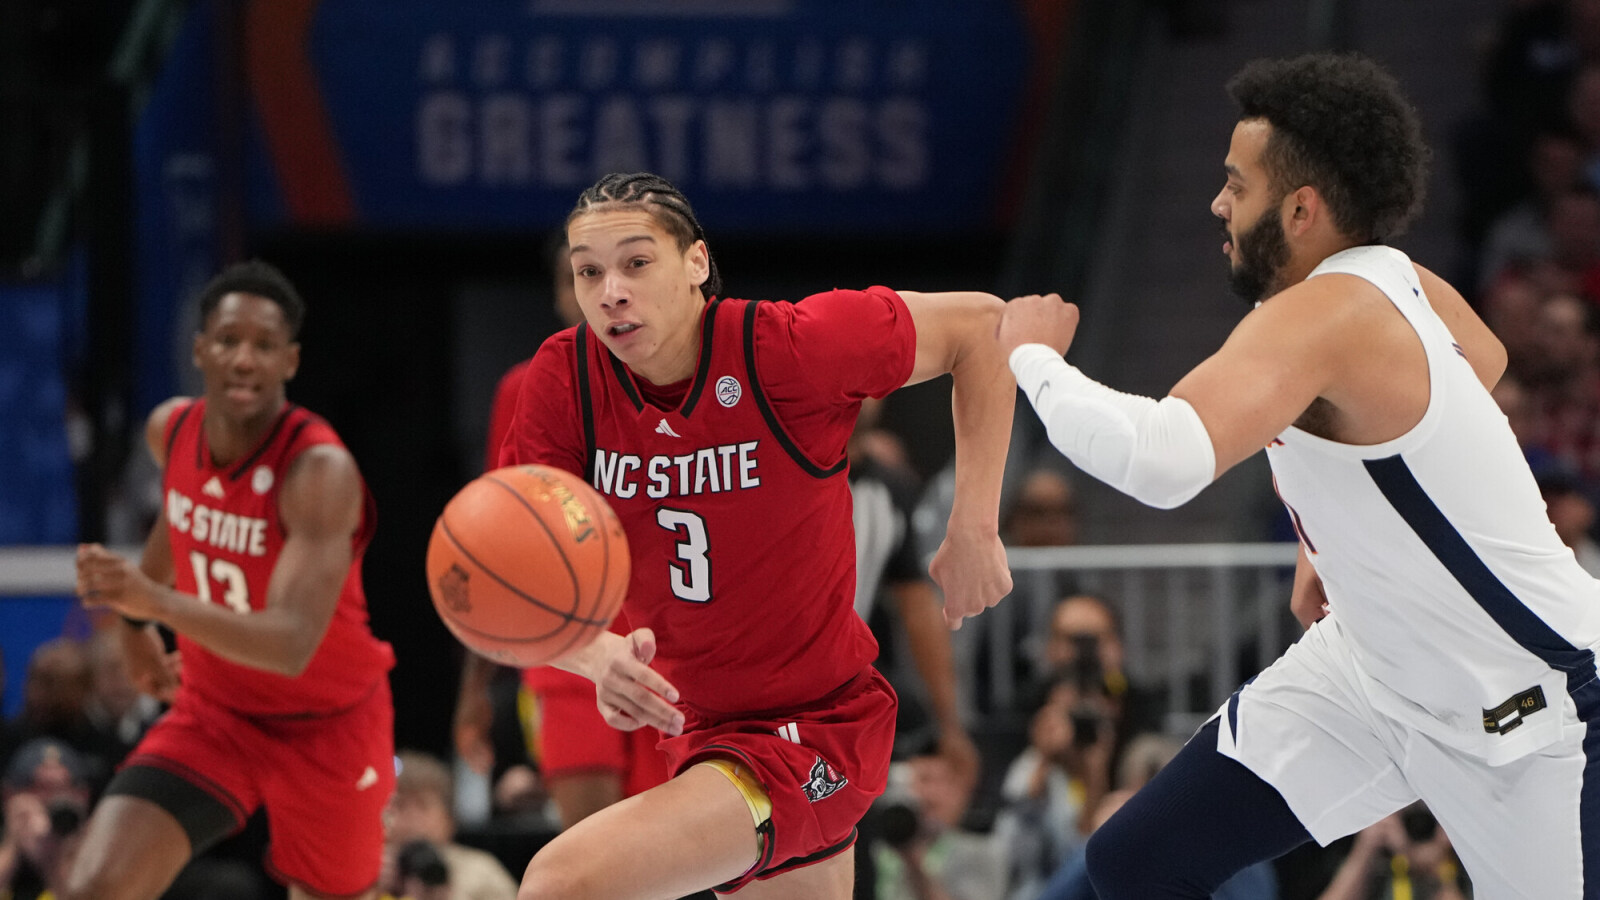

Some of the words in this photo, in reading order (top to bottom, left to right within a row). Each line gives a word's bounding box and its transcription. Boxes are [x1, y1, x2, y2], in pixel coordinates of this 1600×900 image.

[417, 95, 931, 187] GREATNESS
[720, 384, 738, 394] ACC
[593, 447, 642, 500] NC
[646, 440, 760, 499] STATE
[167, 488, 193, 534] NC
[191, 504, 268, 557] STATE
[655, 505, 714, 603] 3
[189, 549, 251, 616] 13
[1521, 696, 1535, 708] 46
